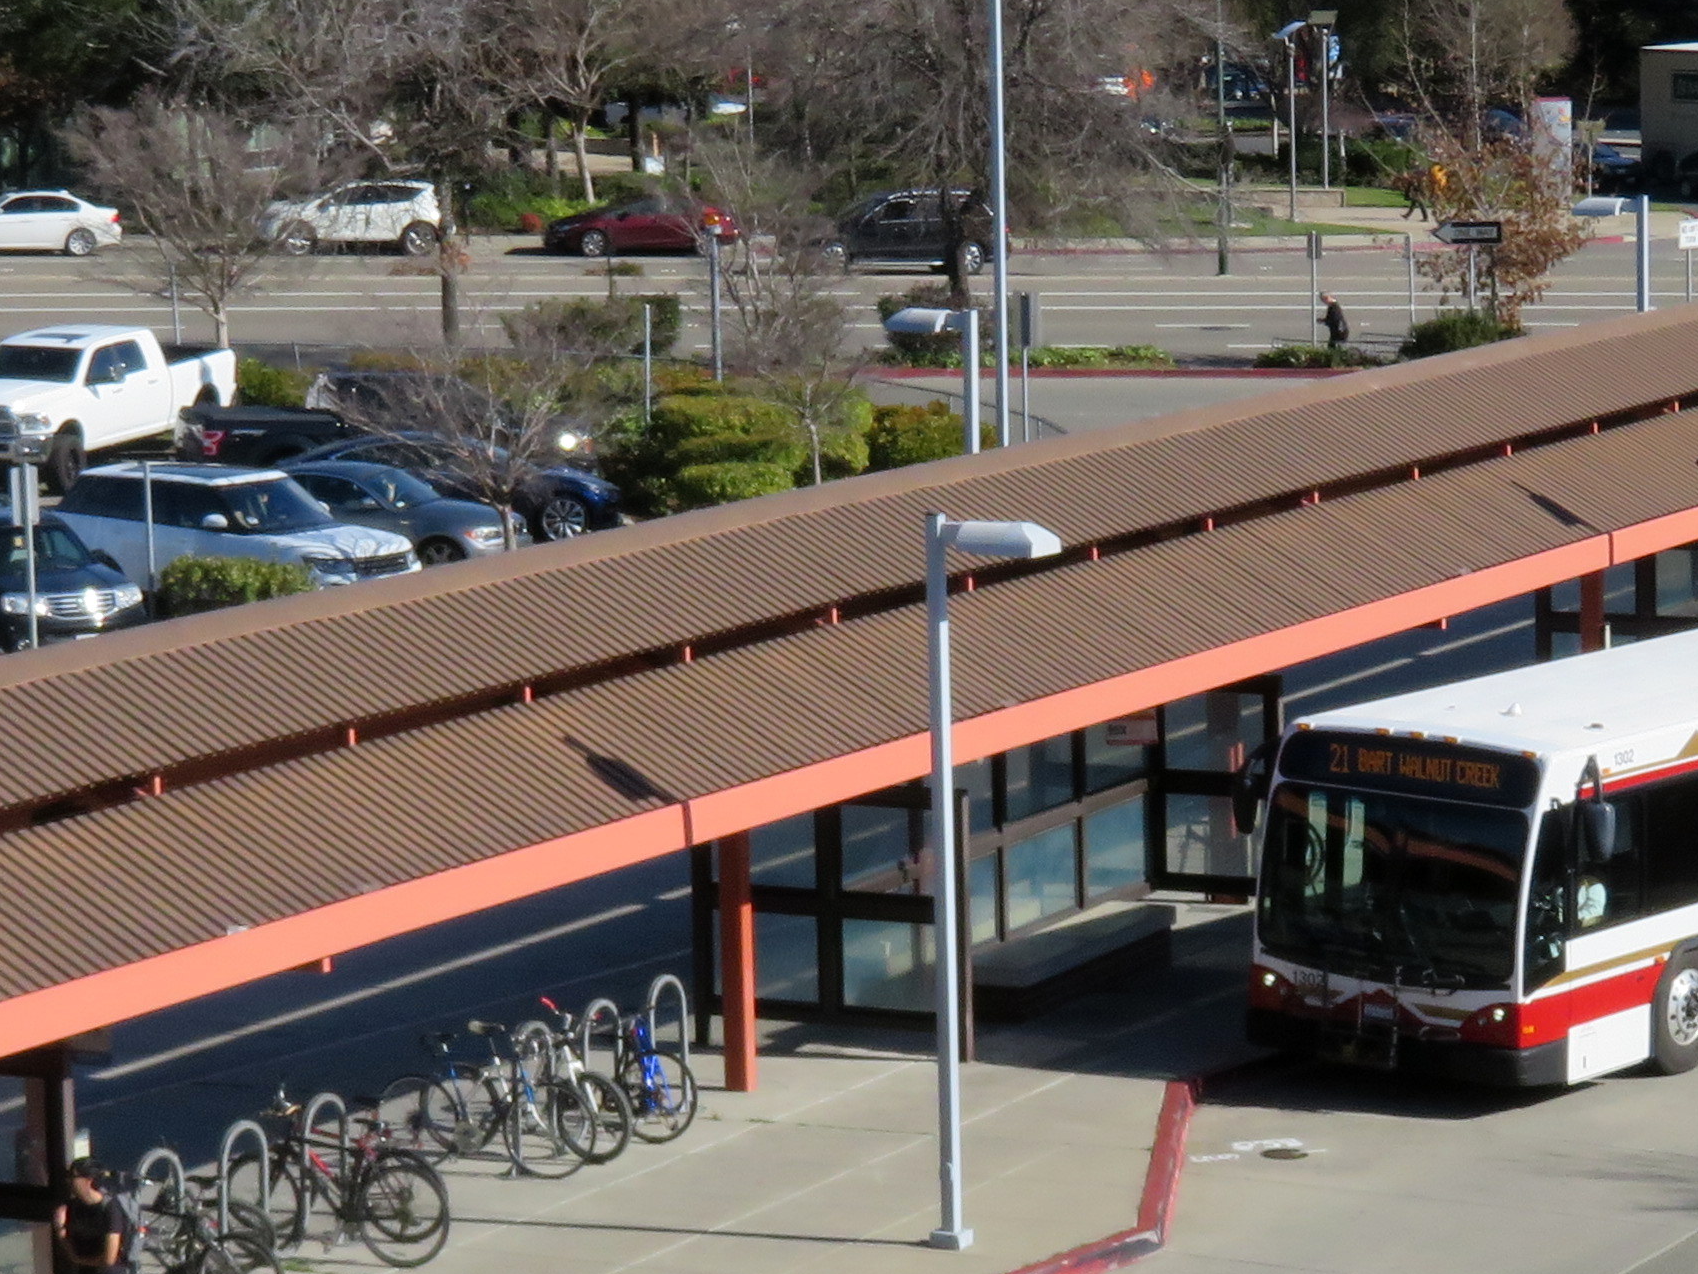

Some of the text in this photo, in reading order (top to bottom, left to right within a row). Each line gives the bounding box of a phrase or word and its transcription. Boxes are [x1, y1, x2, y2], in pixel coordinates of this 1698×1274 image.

[1330, 743, 1500, 789] 21 BART WALNUT CREEK
[1614, 748, 1635, 766] 1302
